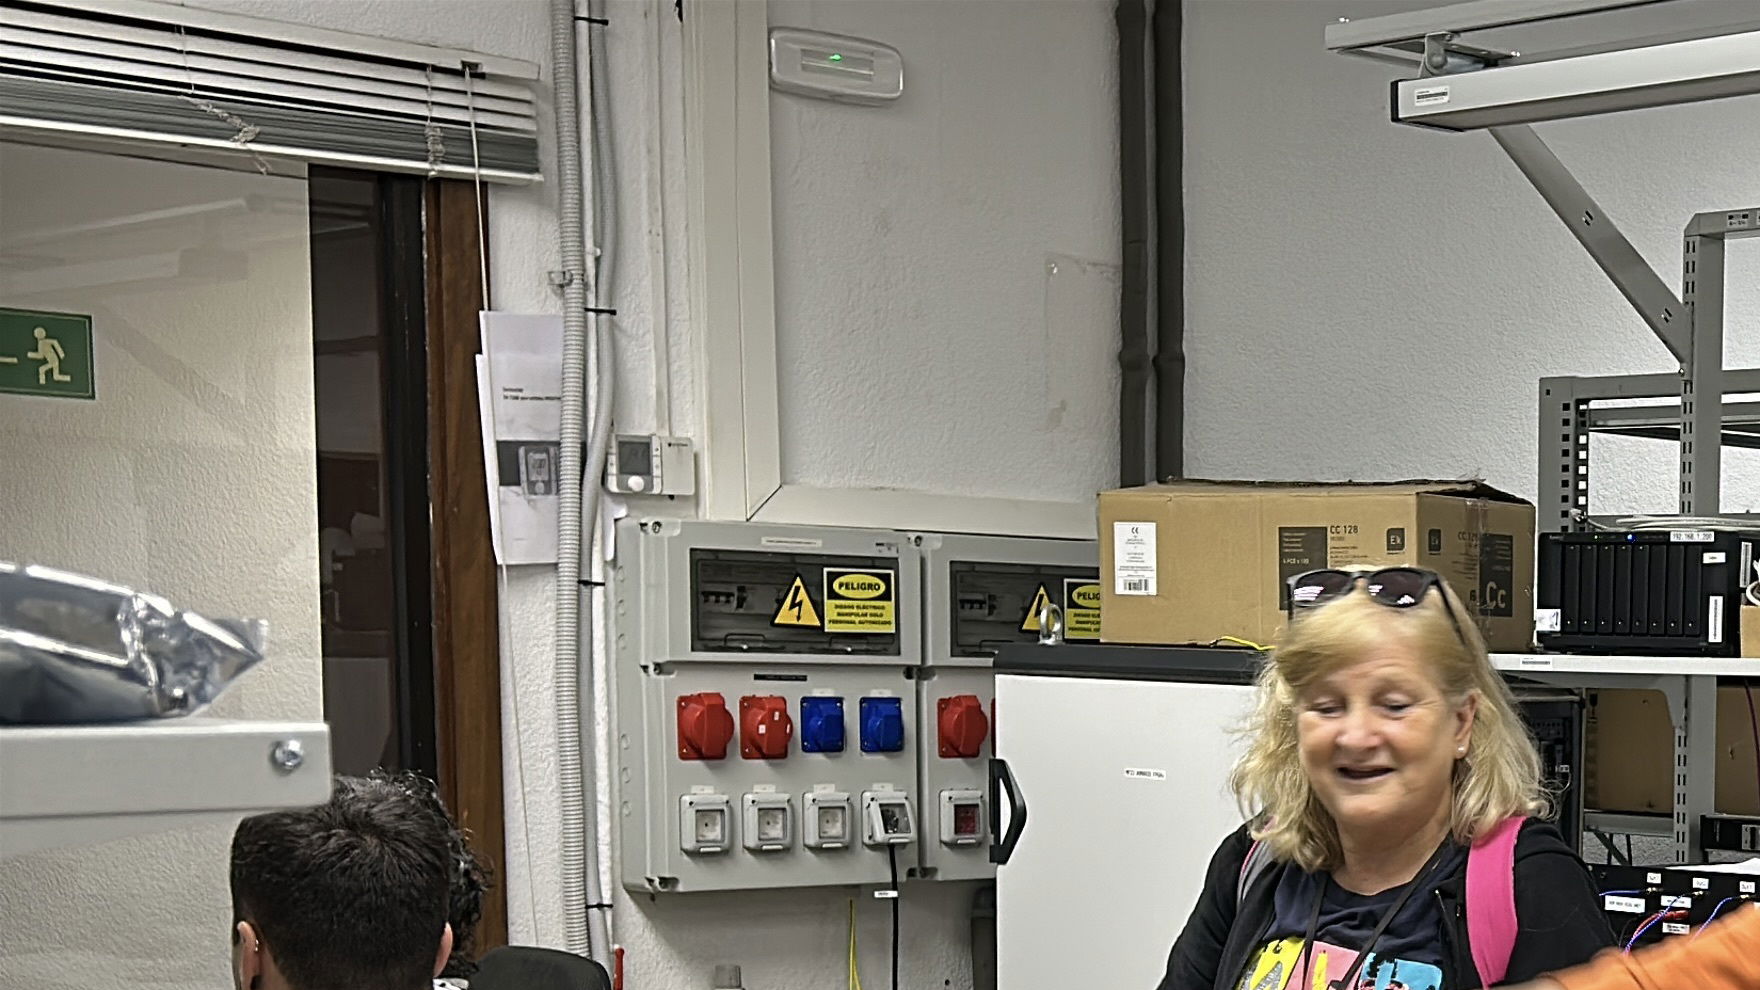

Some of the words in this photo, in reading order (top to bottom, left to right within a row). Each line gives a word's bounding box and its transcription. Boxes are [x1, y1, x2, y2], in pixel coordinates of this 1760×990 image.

[1329, 525, 1341, 535] CC
[1343, 525, 1359, 535] 128
[838, 582, 881, 592] PELIGRO
[1077, 591, 1100, 601] PELIG
